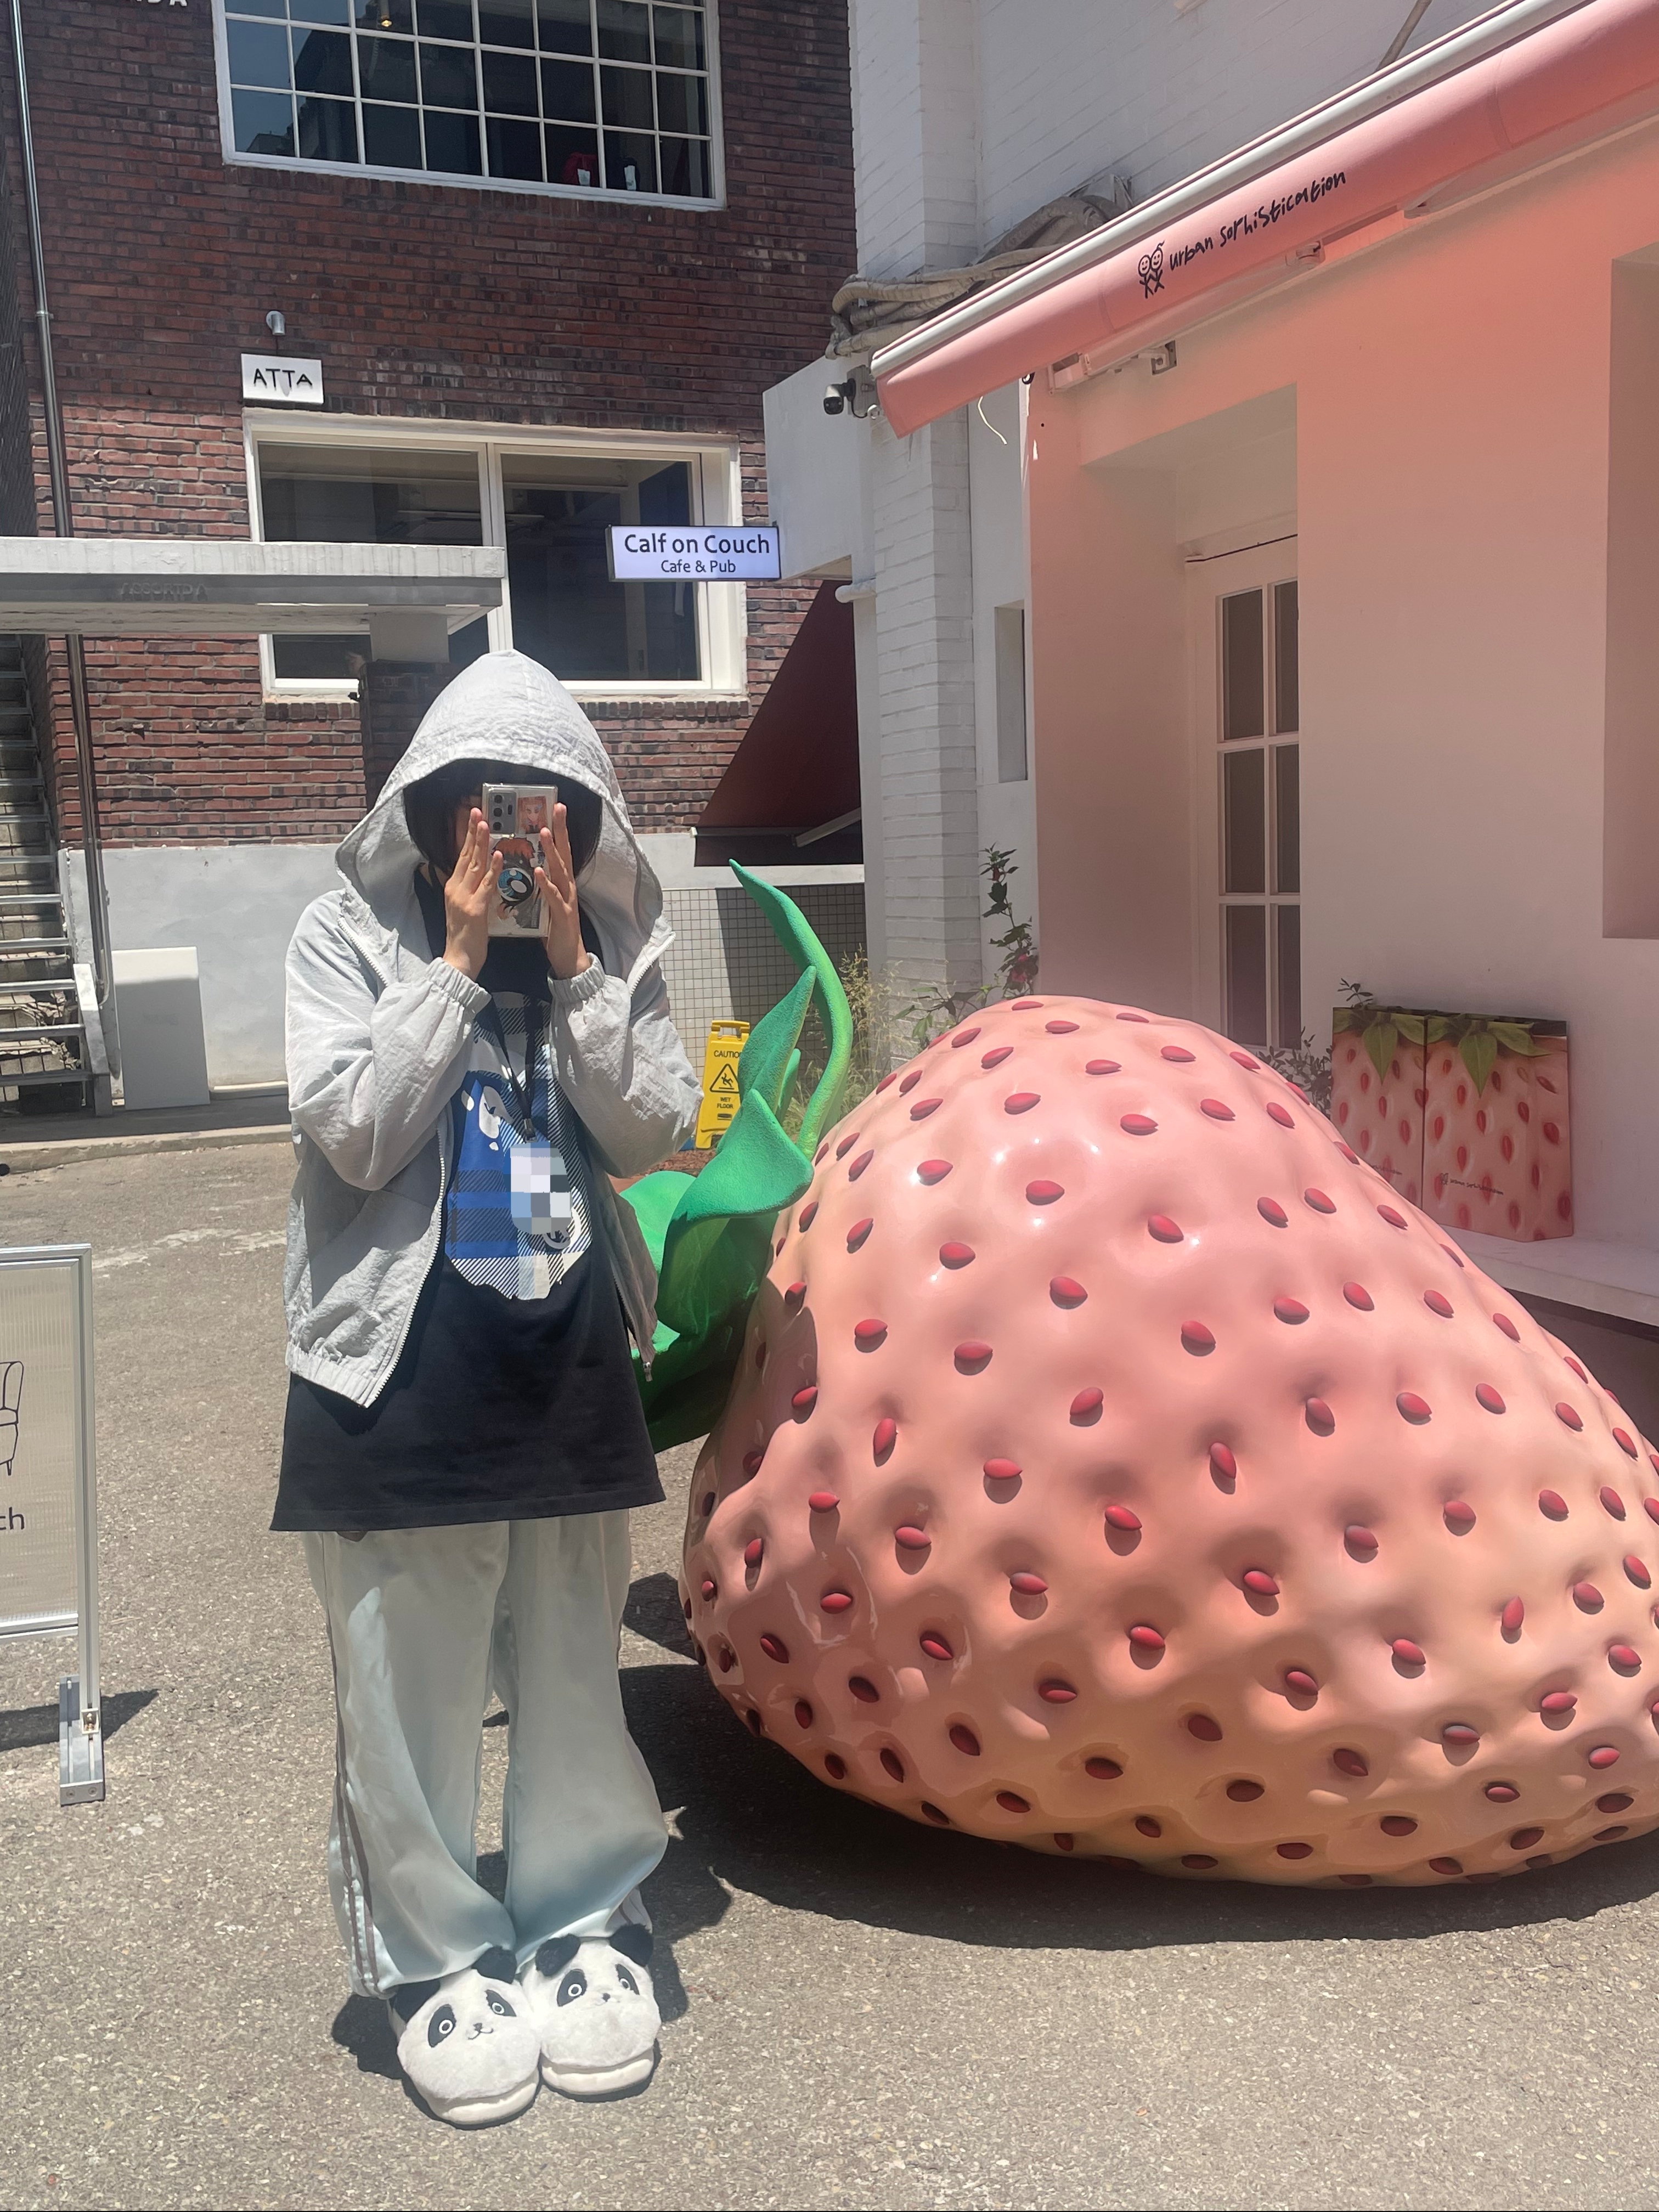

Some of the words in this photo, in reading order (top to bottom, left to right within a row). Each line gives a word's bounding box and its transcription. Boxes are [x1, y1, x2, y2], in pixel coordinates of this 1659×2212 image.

[1170, 236, 1214, 271] urban
[254, 368, 313, 388] ATTA
[625, 533, 666, 552] Calf
[672, 539, 698, 553] on
[704, 534, 770, 554] Couch
[661, 560, 690, 572] Cafe
[696, 561, 706, 572] &
[710, 560, 736, 572] Pub
[714, 1049, 740, 1058] CAUTIO
